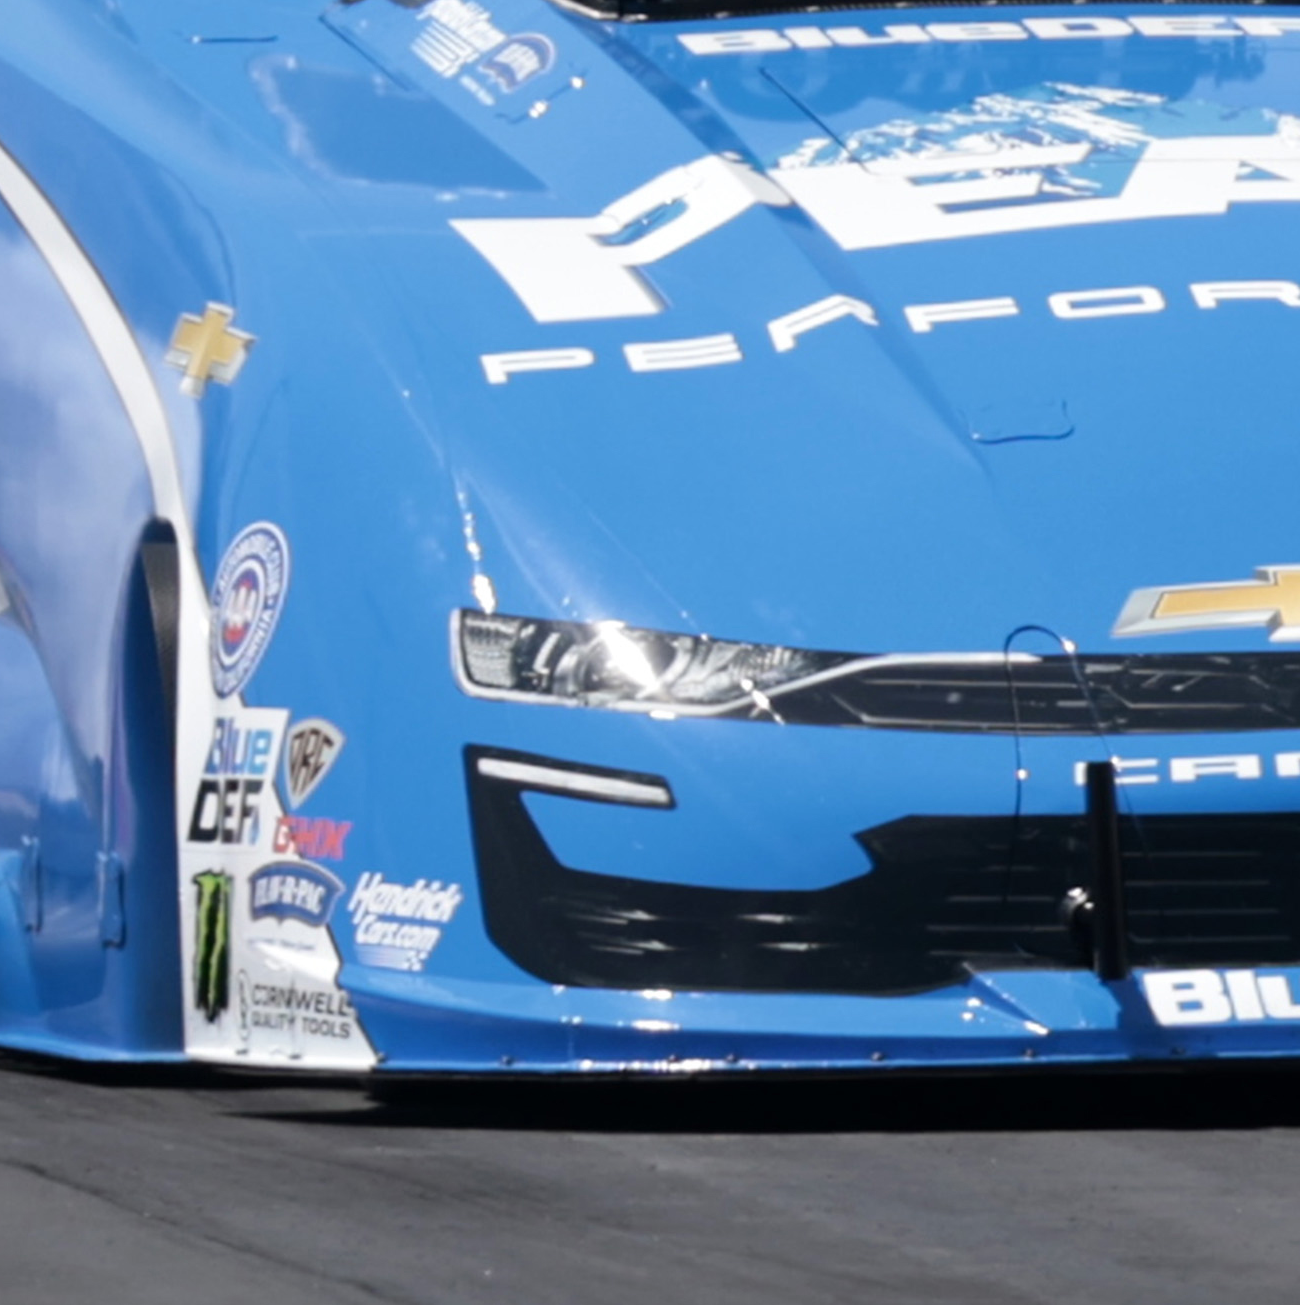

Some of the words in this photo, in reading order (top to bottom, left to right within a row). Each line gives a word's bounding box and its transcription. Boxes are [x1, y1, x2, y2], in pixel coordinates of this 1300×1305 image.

[204, 716, 273, 775] Blue
[187, 779, 264, 845] DEF
[347, 871, 461, 924] Hendrick
[252, 983, 353, 1016] CORNWELL
[302, 1013, 352, 1040] TOOLS
